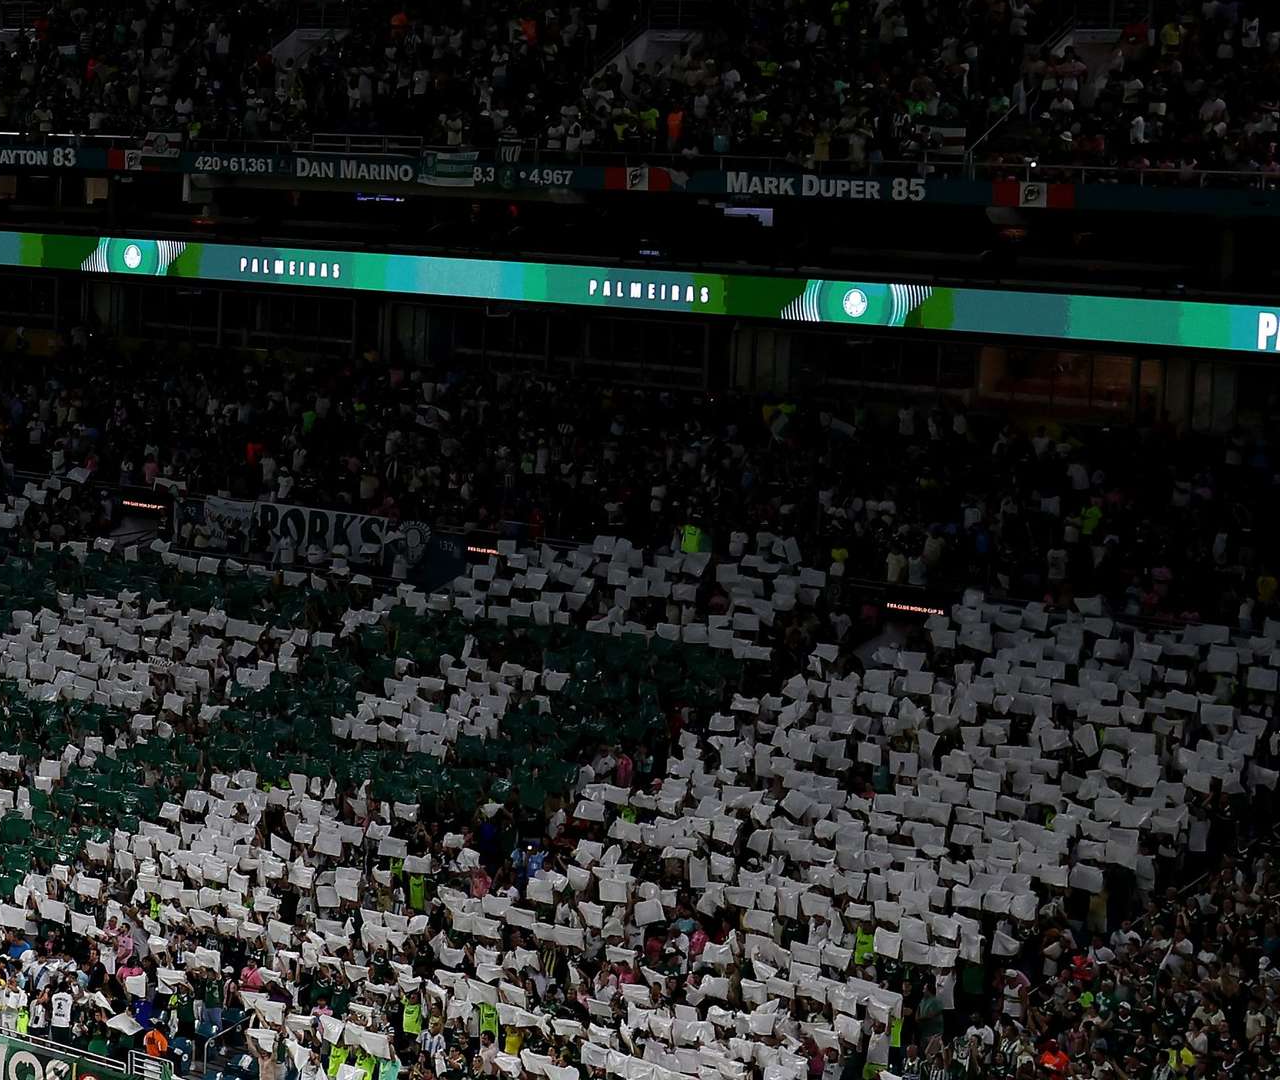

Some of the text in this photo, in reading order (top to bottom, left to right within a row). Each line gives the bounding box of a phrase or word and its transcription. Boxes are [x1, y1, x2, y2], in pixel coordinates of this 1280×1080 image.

[53, 147, 77, 168] 83
[891, 177, 926, 202] 85
[240, 256, 341, 279] PALMEIRAS
[589, 279, 710, 304] PALMEIRAS
